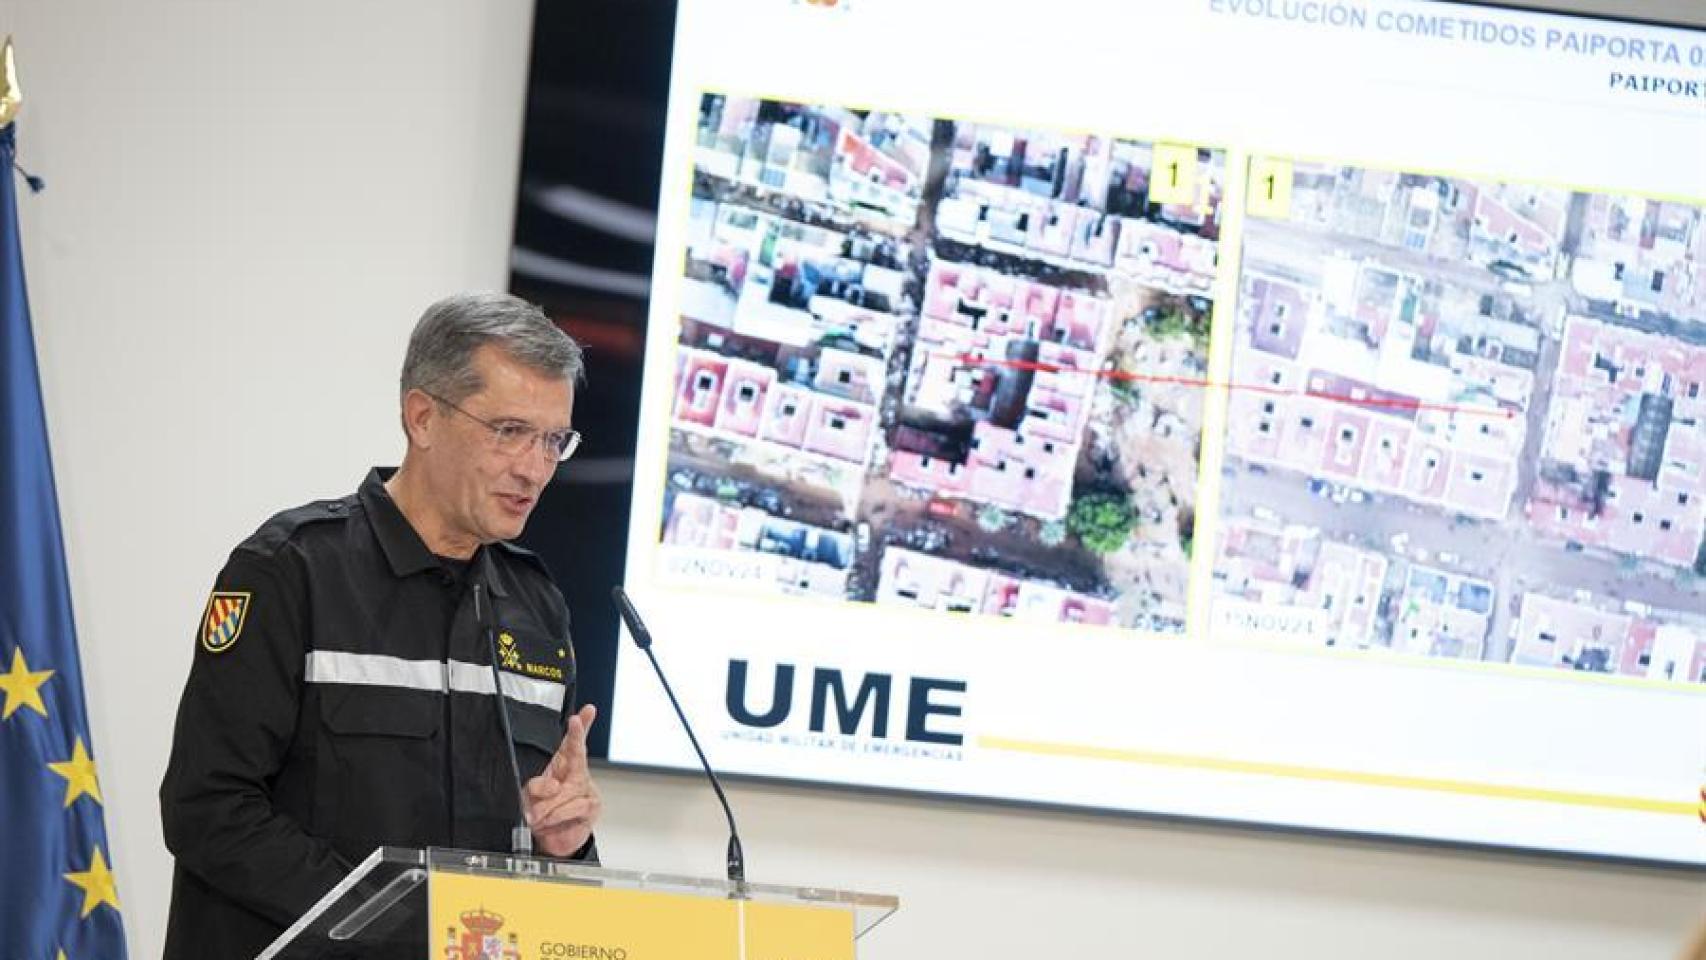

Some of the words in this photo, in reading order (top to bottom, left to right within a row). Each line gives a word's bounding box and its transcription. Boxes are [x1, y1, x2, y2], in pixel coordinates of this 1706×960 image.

[1209, 0, 1367, 30] EVOLUCIÓN
[1376, 10, 1537, 49] COMETIDOS
[1545, 28, 1681, 64] PAIPORTA
[1168, 162, 1177, 188] 1
[1264, 174, 1274, 200] 1
[526, 662, 562, 679] MARCOS
[725, 658, 967, 746] UME
[720, 730, 774, 744] UNIDAD
[780, 735, 835, 749] MILITAR
[841, 740, 857, 752] DE
[864, 742, 963, 761] EMERGENCIAS
[540, 942, 626, 960] GOBIERNO
